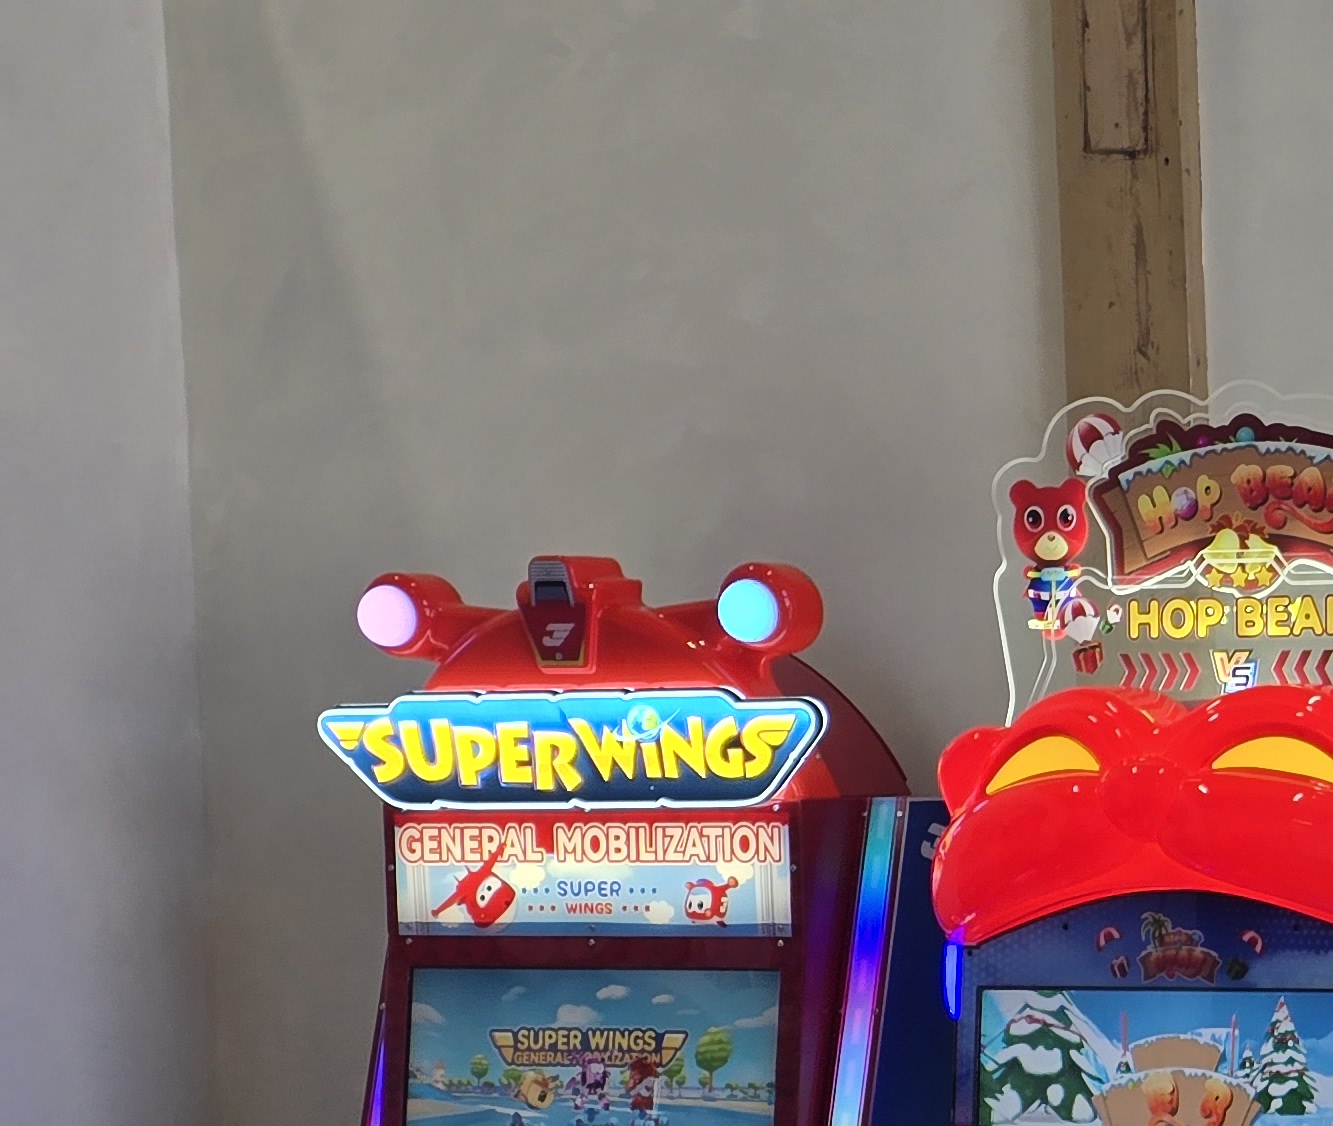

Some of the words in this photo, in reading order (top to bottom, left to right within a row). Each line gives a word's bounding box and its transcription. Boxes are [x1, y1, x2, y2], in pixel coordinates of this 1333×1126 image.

[1137, 474, 1222, 534] HOP
[1128, 597, 1224, 639] HOP
[361, 717, 585, 792] SUPER
[400, 823, 544, 863] GENERAL
[555, 823, 783, 863] MOBILIZATION
[556, 880, 622, 898] SUPER
[565, 902, 613, 915] WINGS
[517, 1029, 581, 1050] SUPER
[588, 1030, 656, 1050] WINGS
[514, 1051, 570, 1065] GENERAL
